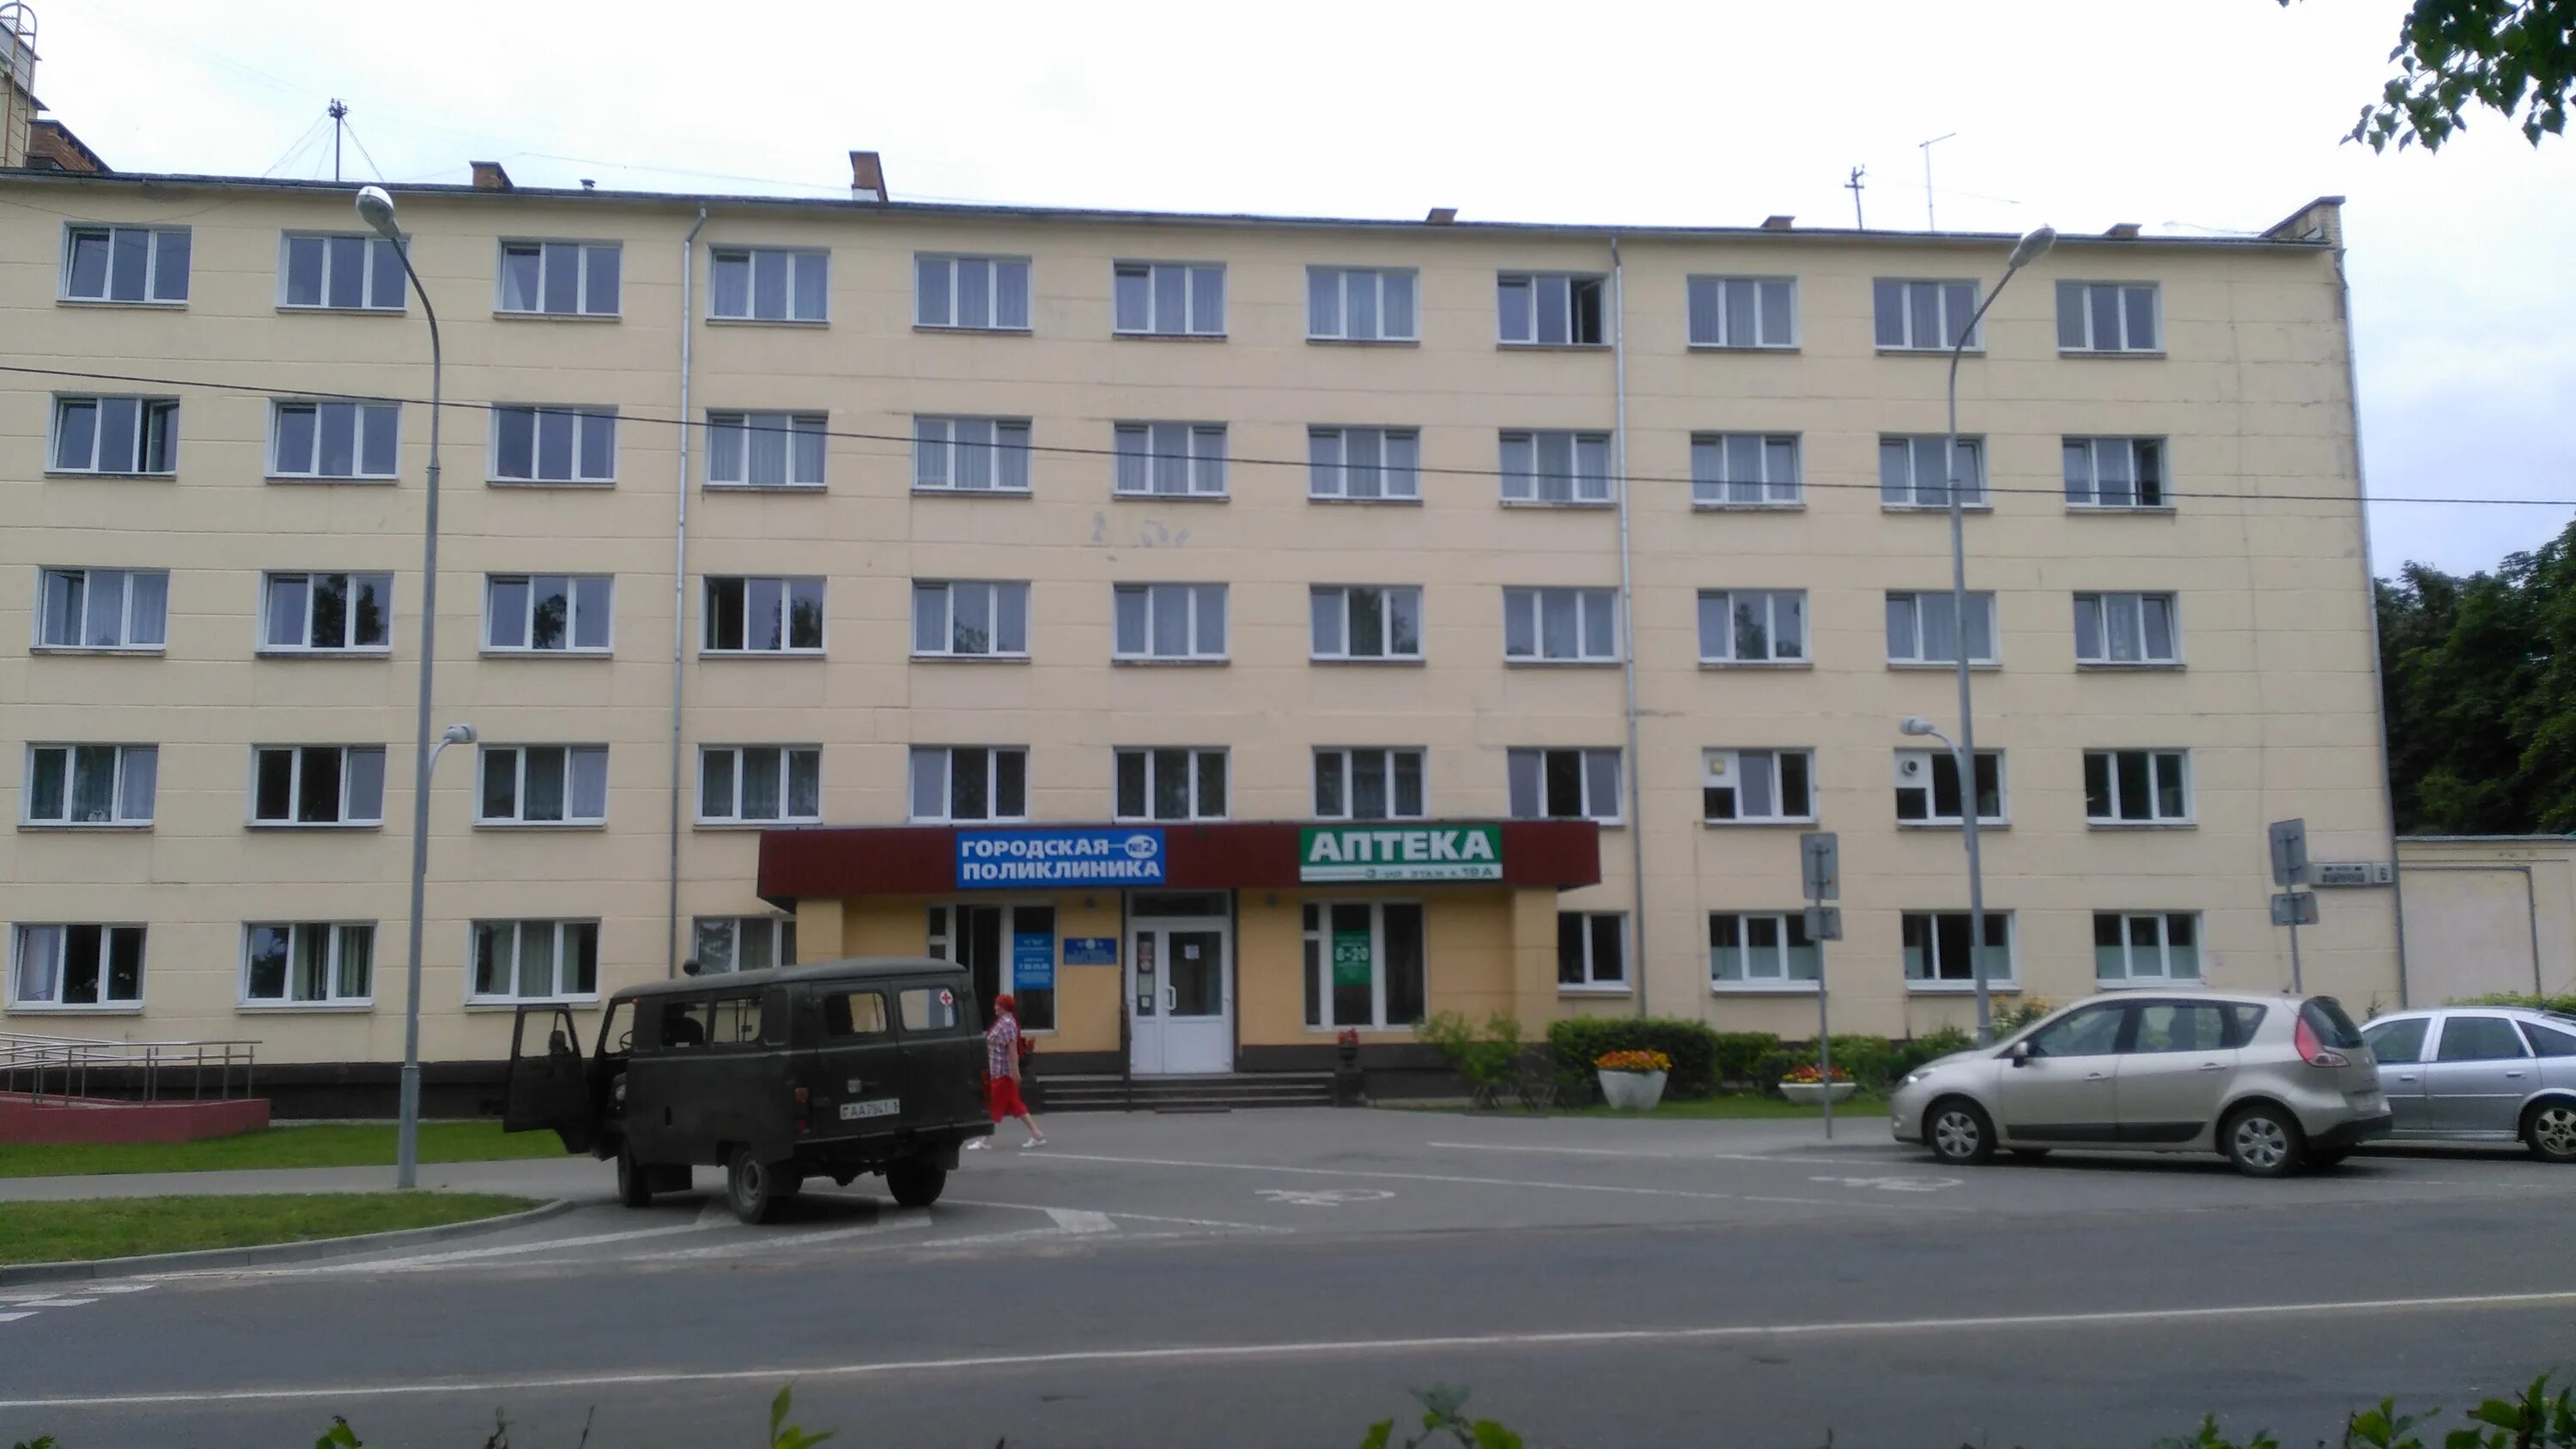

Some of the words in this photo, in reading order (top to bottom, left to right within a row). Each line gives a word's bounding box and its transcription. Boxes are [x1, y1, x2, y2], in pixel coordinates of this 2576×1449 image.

[962, 839, 1109, 858] ГОРОДСКАЯ
[1309, 830, 1494, 862] АПТЕКА
[963, 860, 1161, 880] ПОЛИКЛИНИКА
